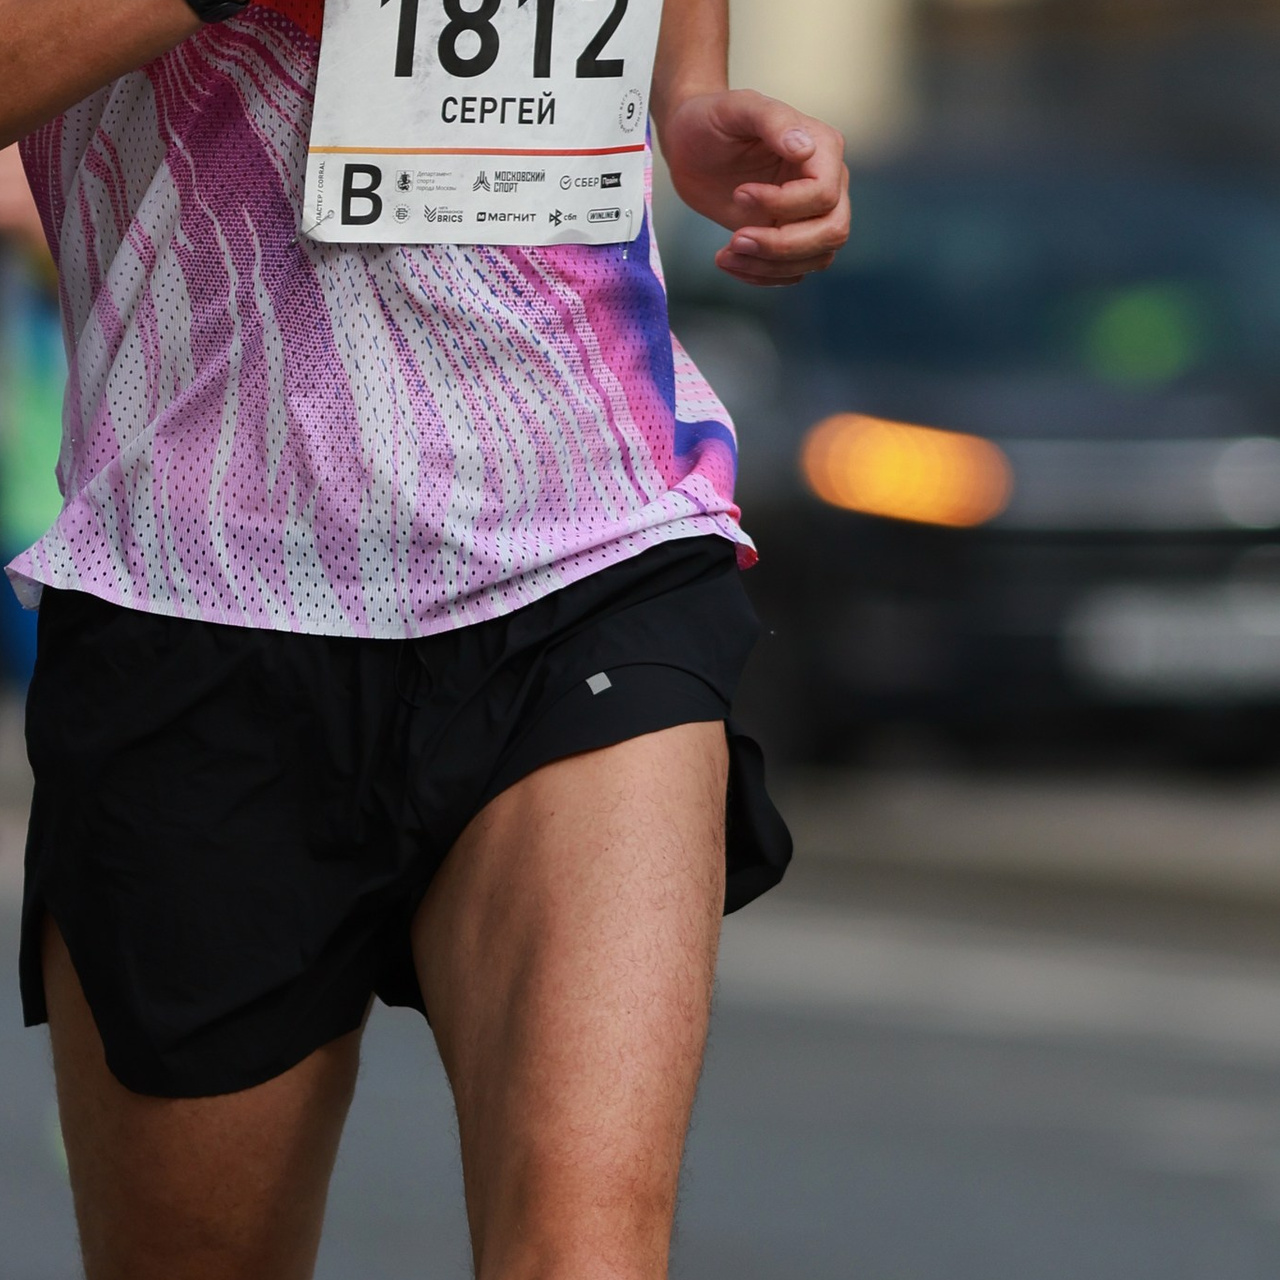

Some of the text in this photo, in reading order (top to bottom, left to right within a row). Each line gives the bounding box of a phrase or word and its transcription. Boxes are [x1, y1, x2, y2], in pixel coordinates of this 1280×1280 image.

[441, 91, 556, 125] СЕРГЕЙ
[626, 102, 635, 120] 9
[494, 169, 546, 182] МОСКОВСКИЙ
[493, 182, 519, 193] СПОРТ
[574, 177, 600, 187] СБЕР
[437, 214, 463, 223] BRICS
